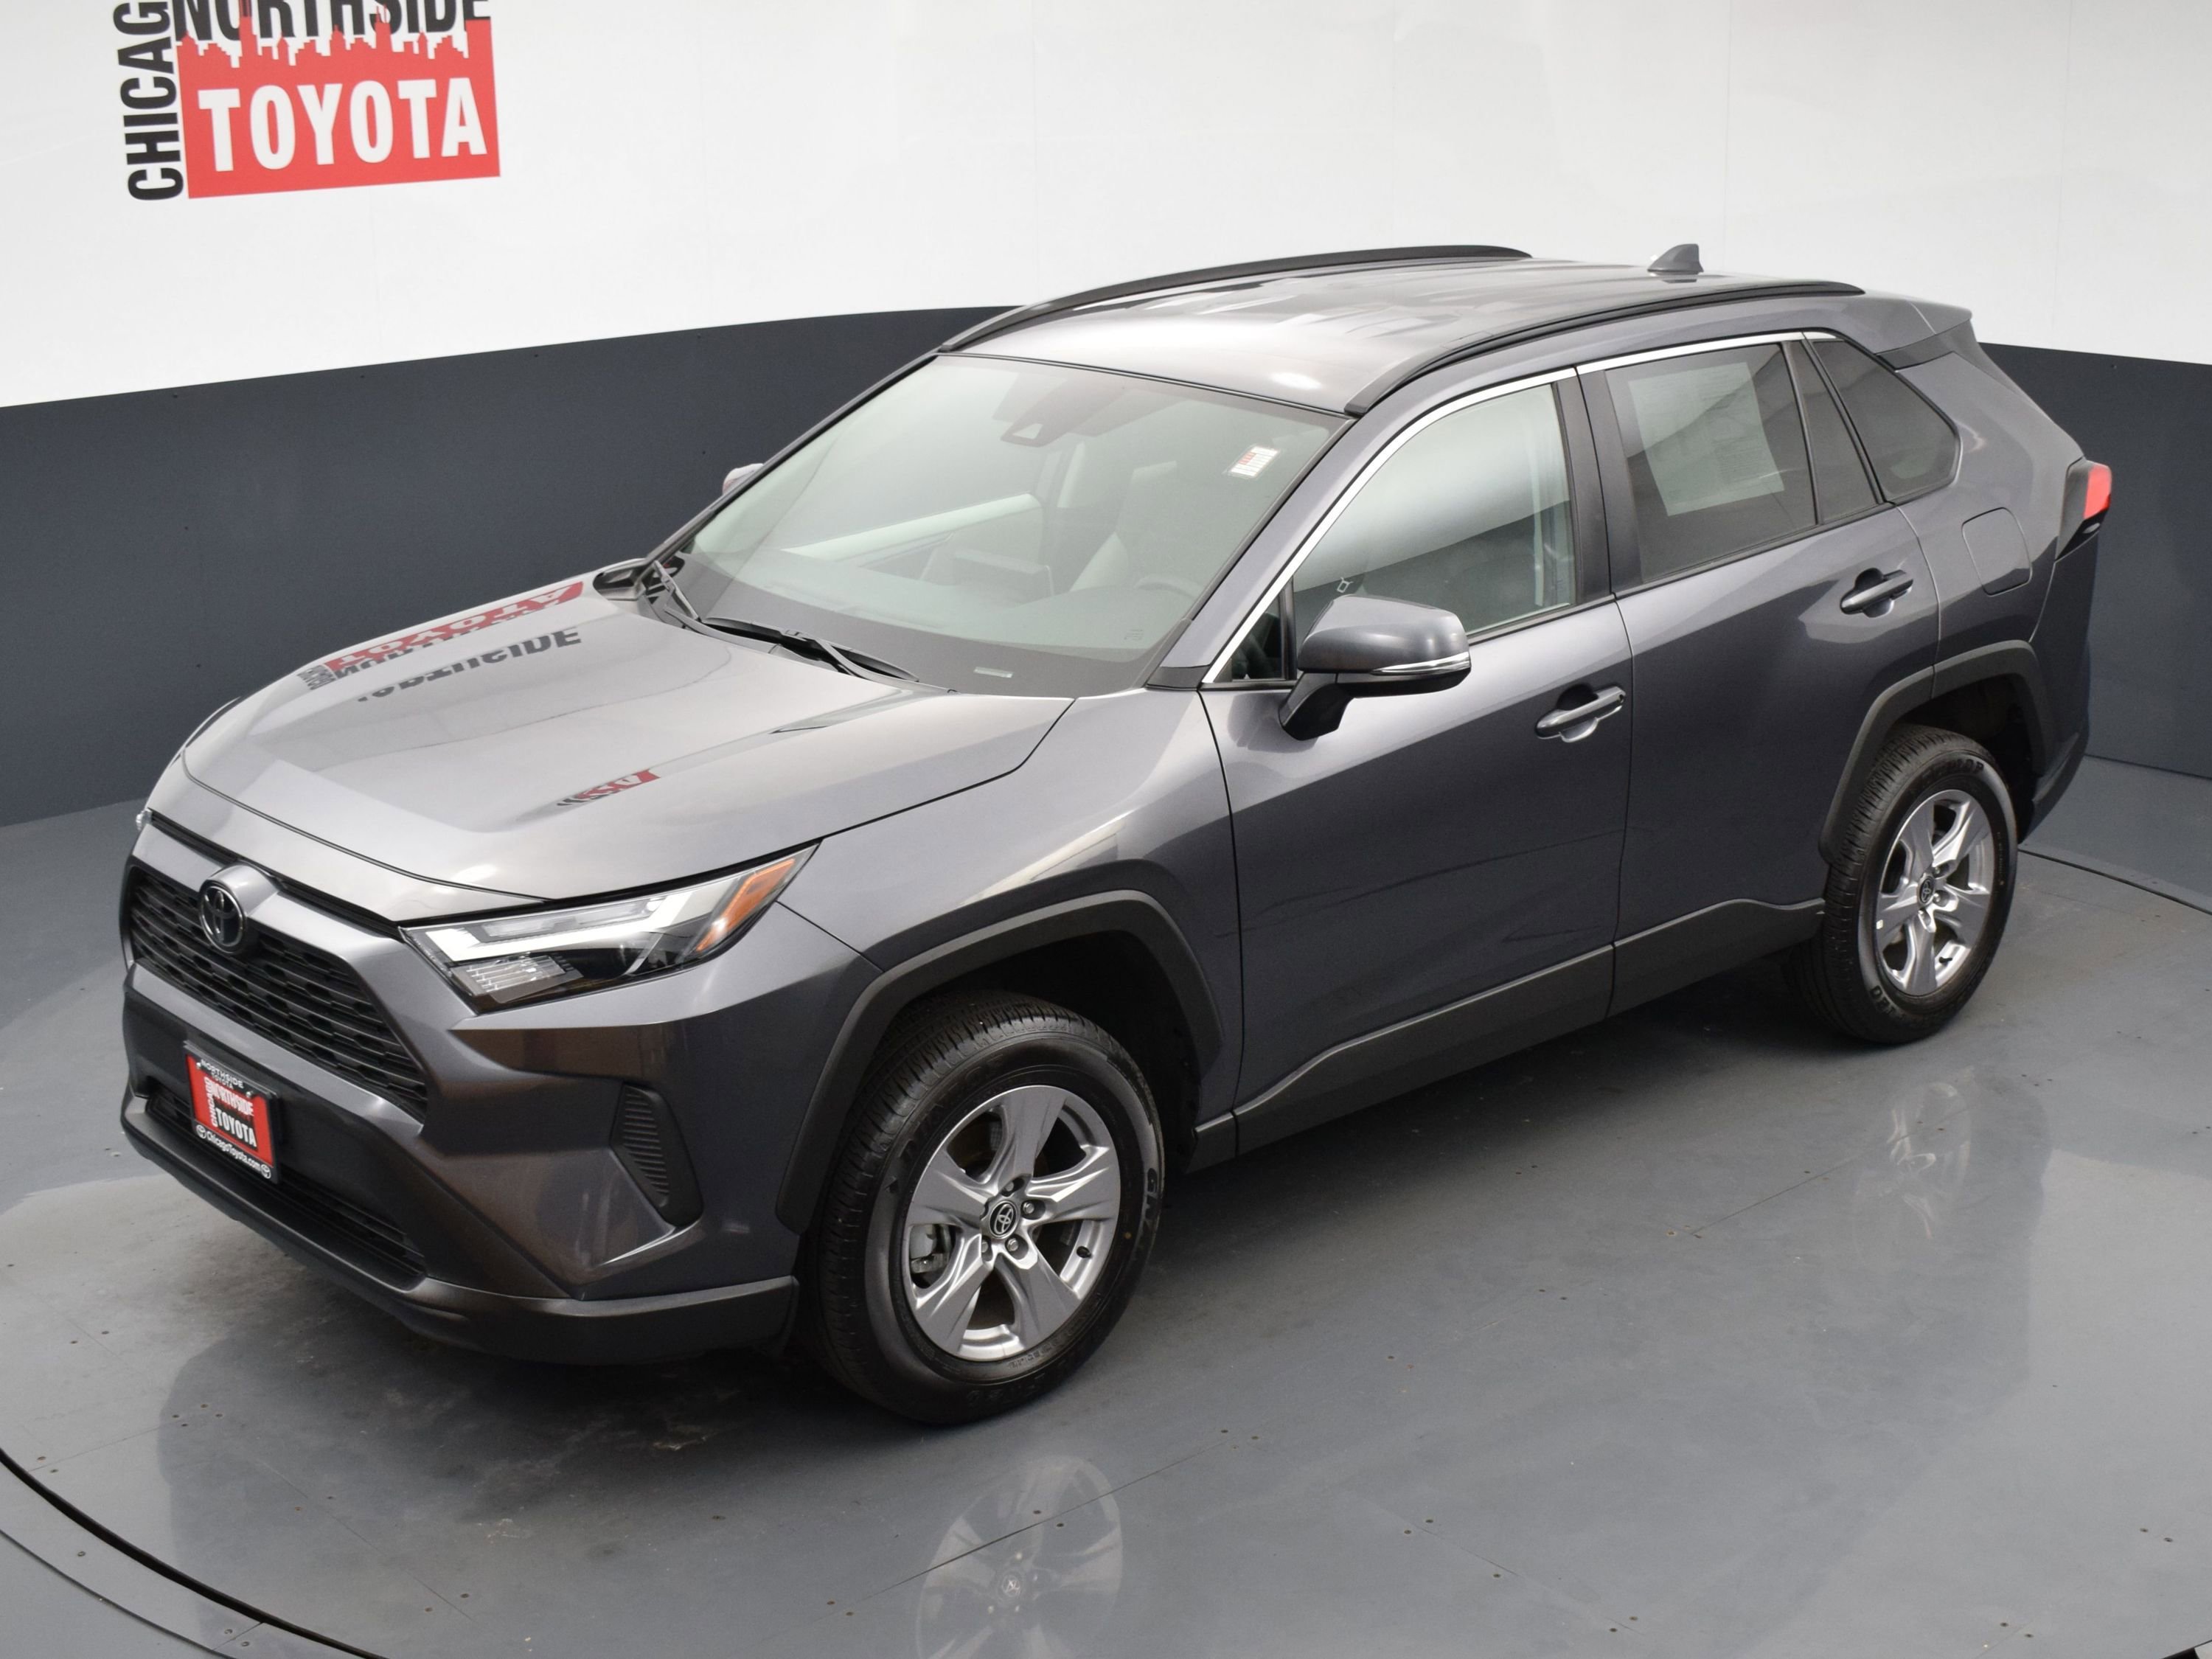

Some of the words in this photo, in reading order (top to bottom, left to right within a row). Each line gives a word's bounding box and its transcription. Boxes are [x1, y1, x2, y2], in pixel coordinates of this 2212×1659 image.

[198, 77, 487, 171] TOYOTA
[201, 1059, 245, 1089] NORTHSIDE
[215, 1107, 257, 1147] TOYOTA
